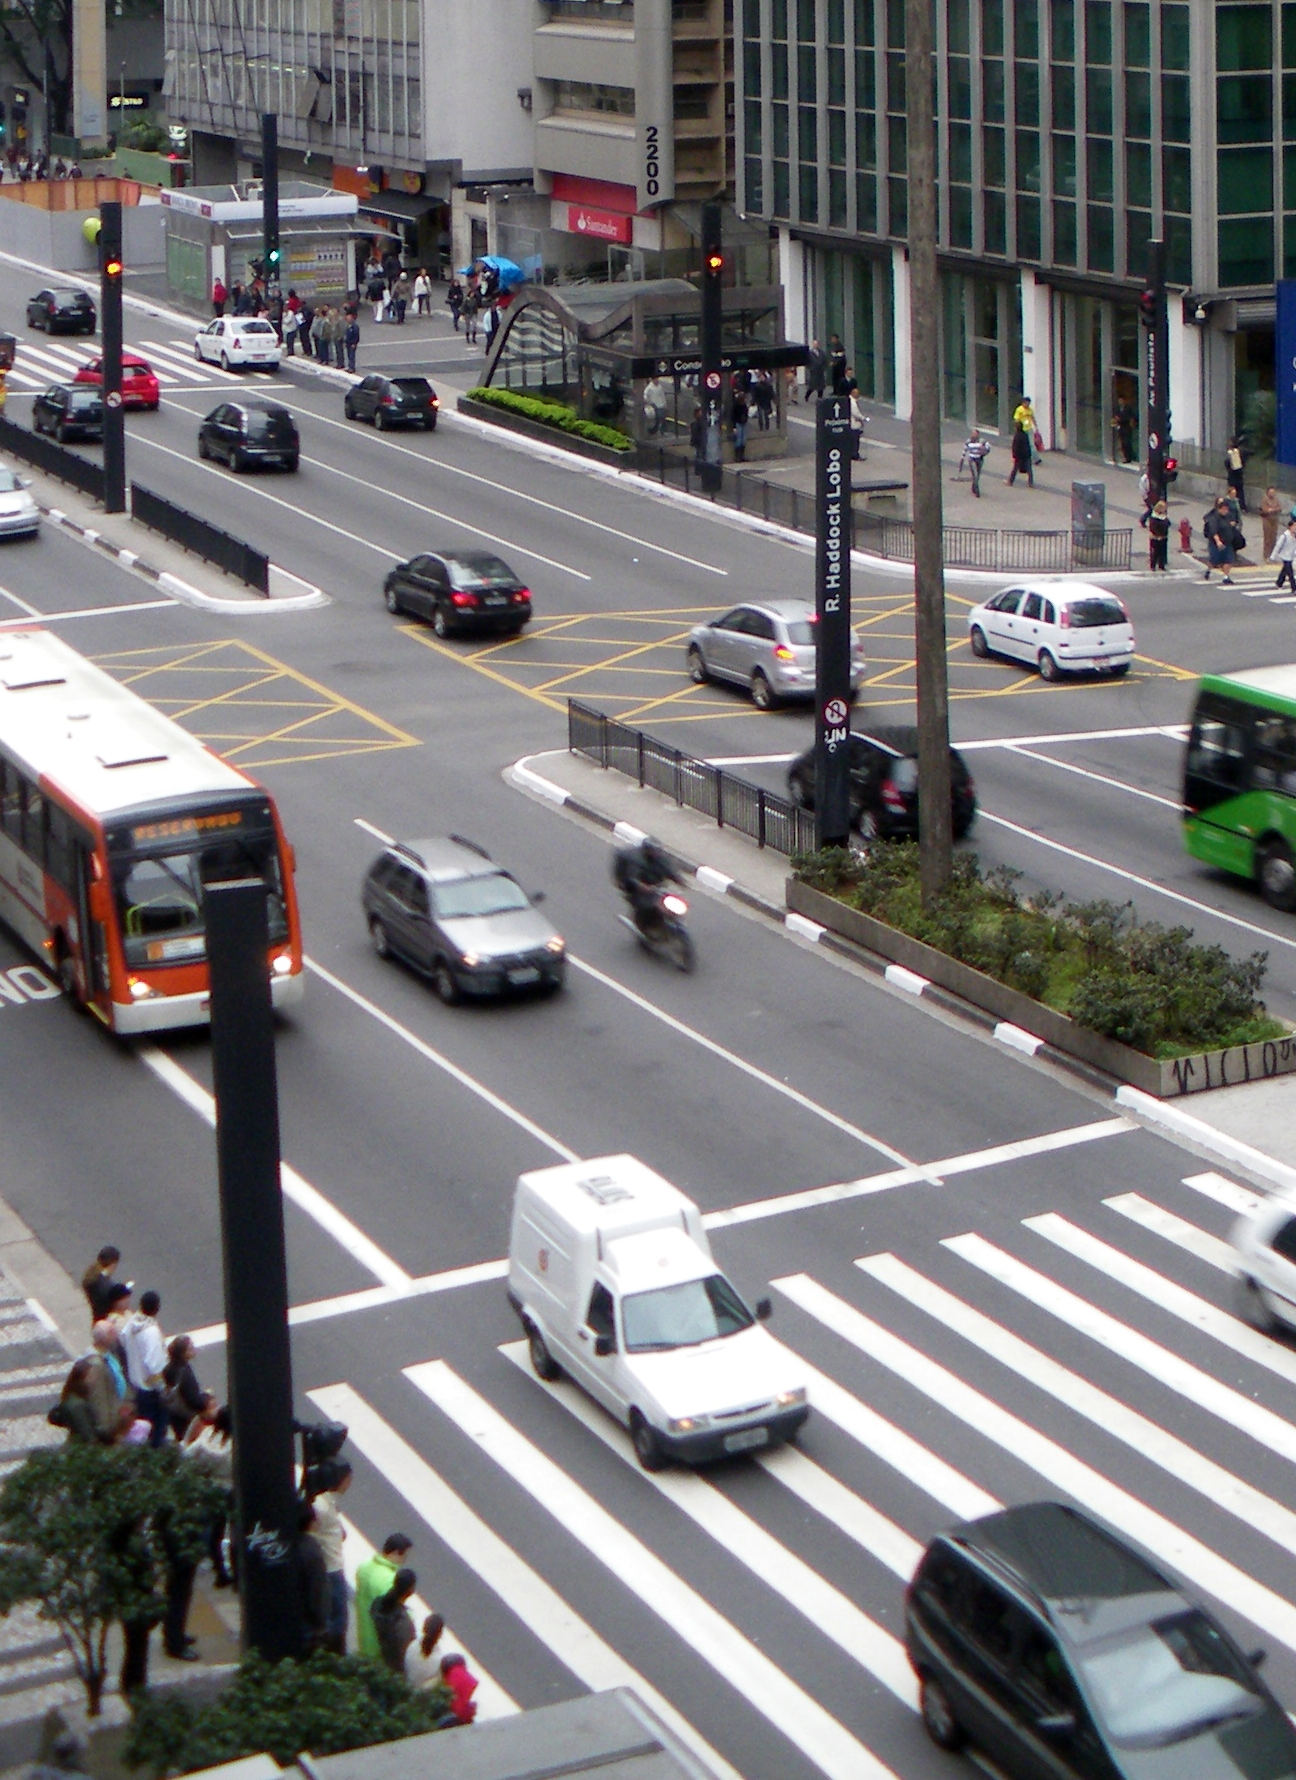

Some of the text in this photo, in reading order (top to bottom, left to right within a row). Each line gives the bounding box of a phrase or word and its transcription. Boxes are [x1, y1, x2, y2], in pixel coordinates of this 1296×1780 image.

[646, 126, 660, 196] 2200
[1147, 332, 1156, 387] Paulista
[825, 448, 842, 612] R. Haddock Lobo
